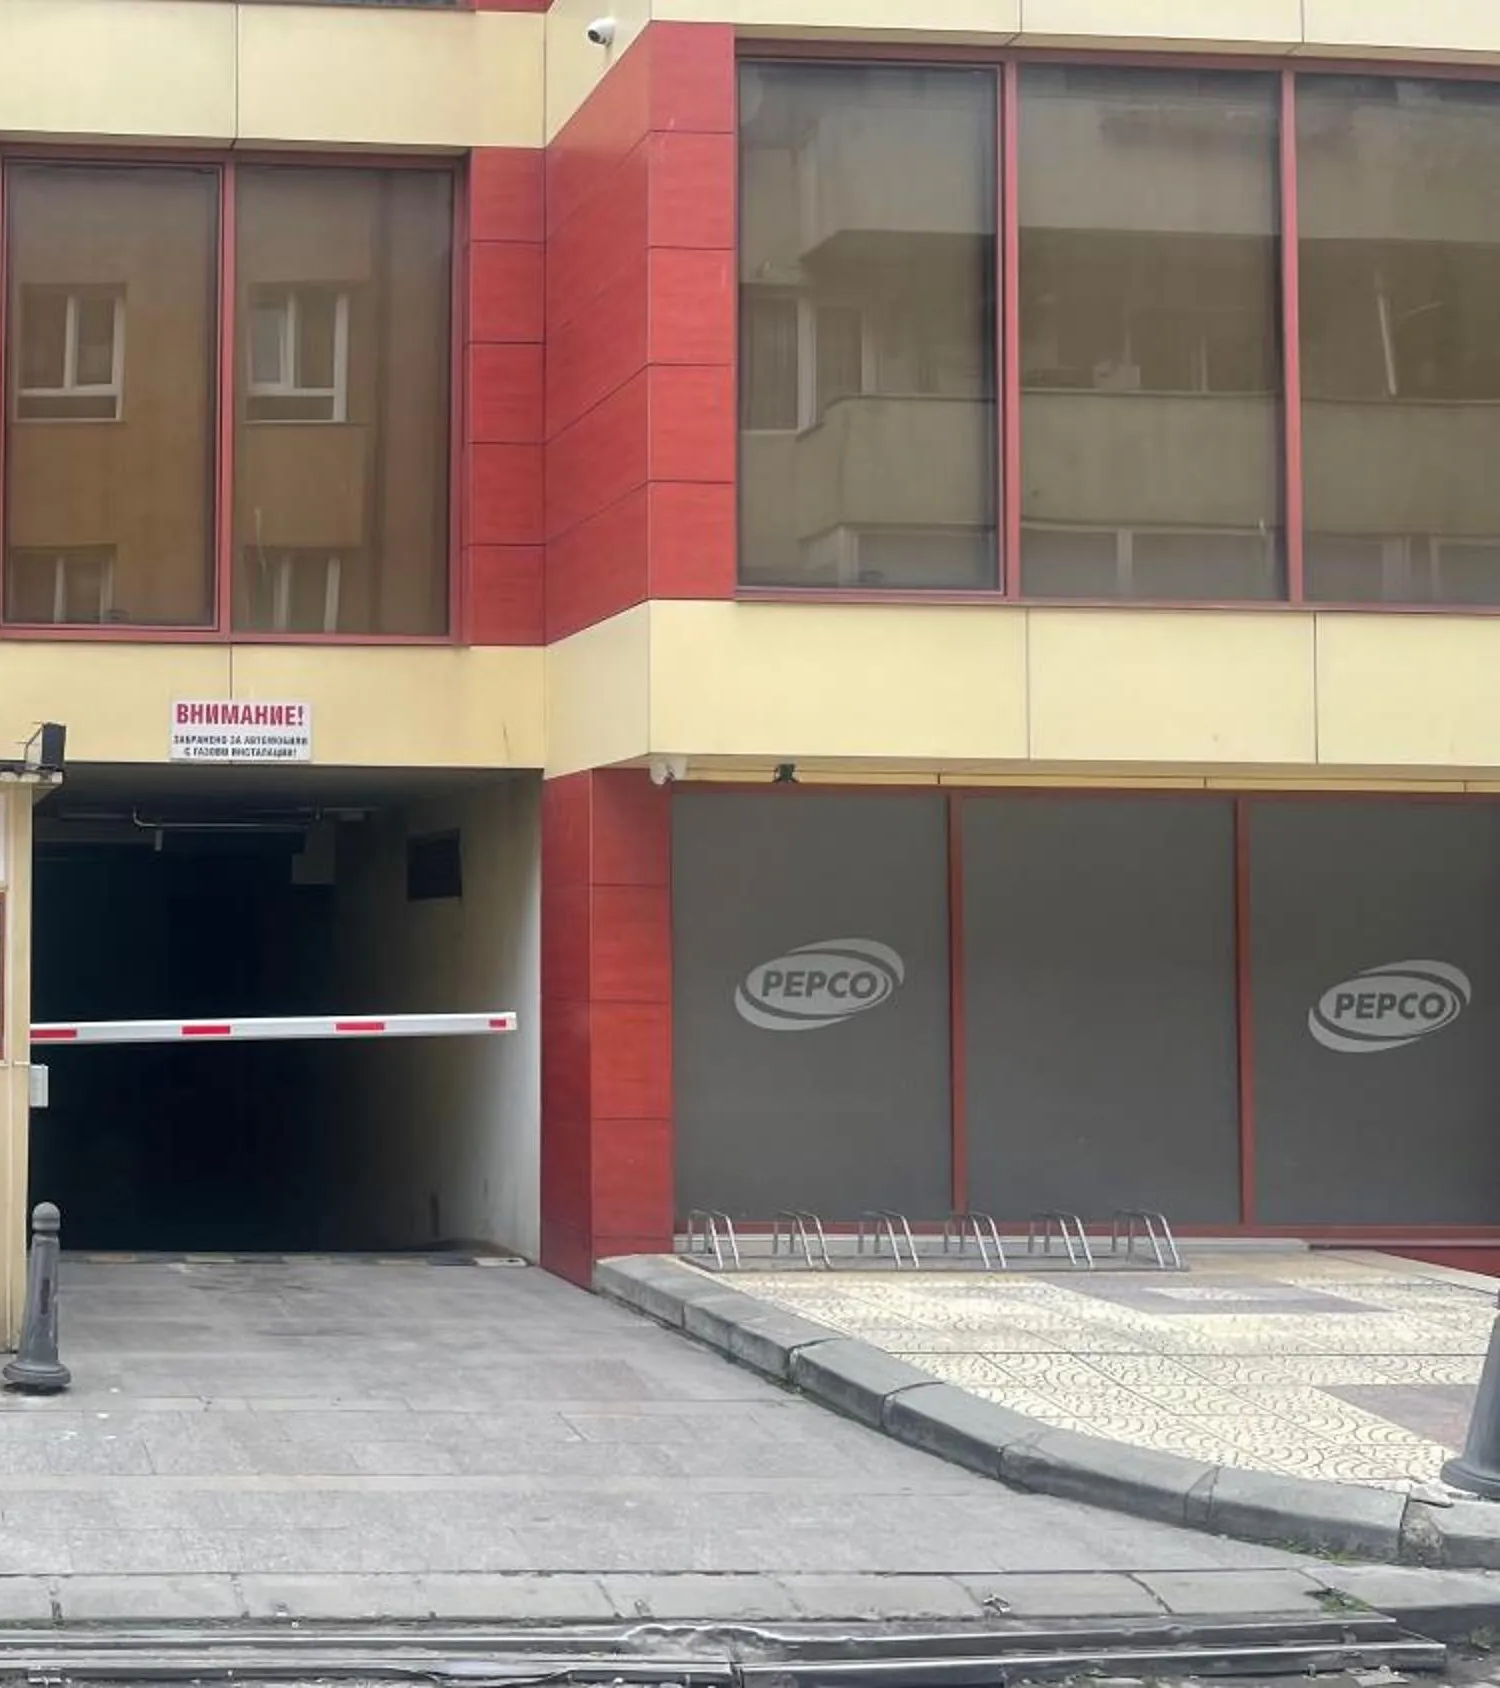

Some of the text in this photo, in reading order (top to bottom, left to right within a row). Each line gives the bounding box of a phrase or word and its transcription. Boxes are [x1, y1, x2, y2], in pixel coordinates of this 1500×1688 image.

[176, 703, 304, 726] ВНИМАНИЕ!
[761, 969, 878, 999] PEPCO
[1333, 992, 1447, 1020] PEPCO
